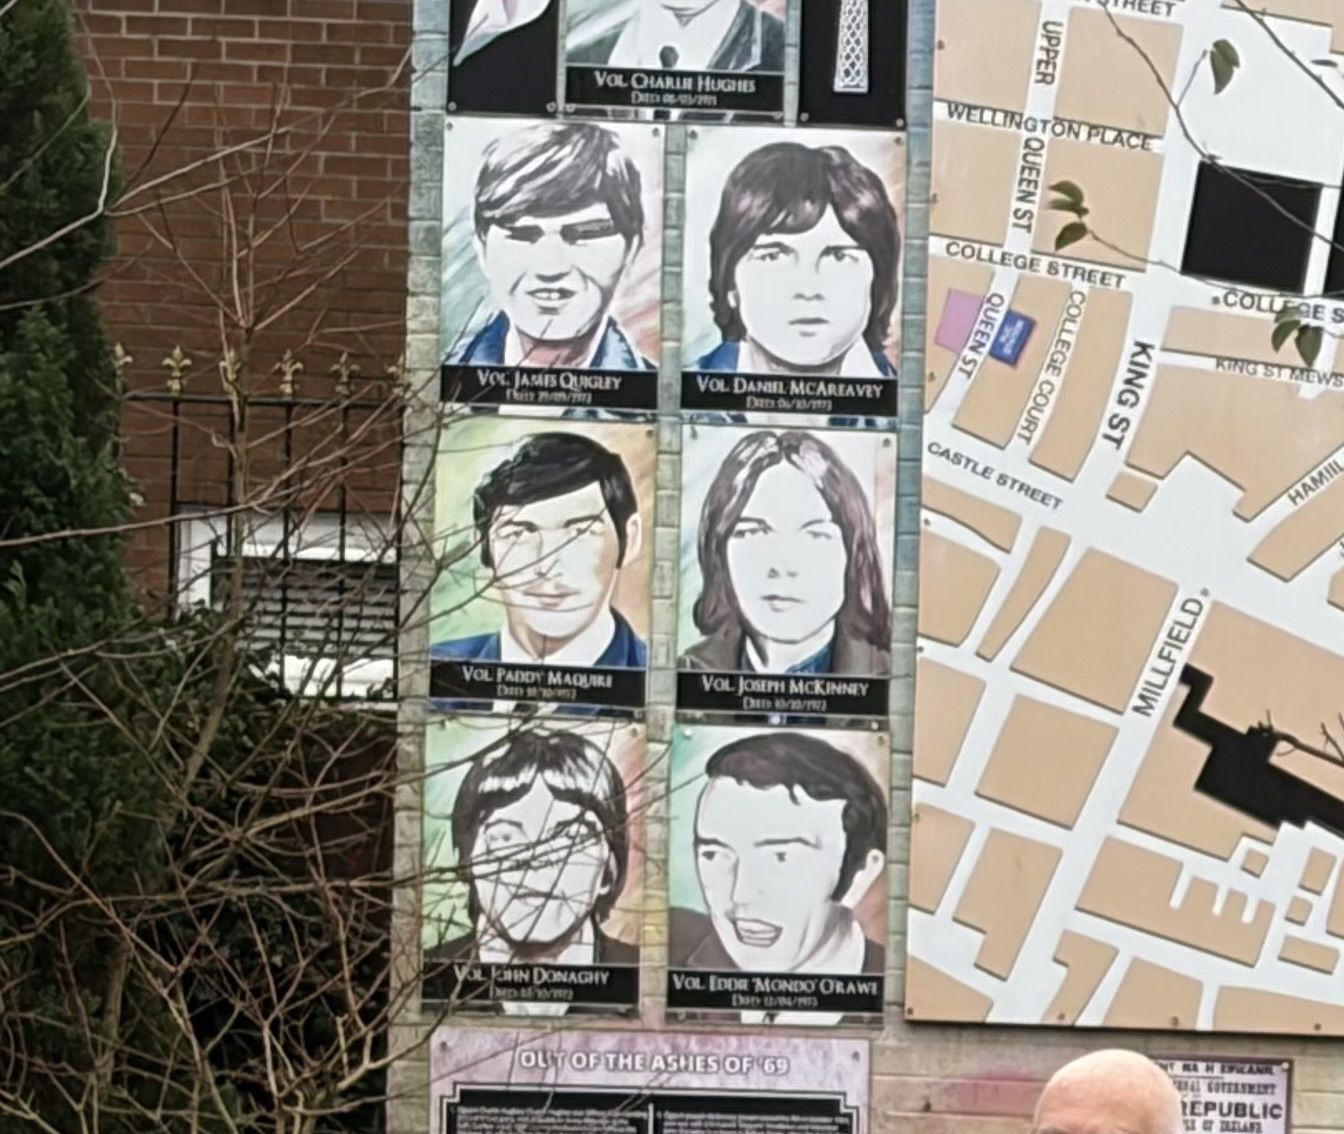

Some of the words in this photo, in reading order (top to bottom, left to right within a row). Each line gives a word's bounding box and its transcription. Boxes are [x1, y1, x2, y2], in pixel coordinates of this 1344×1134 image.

[1033, 19, 1063, 87] UPPER
[631, 72, 693, 91] CHARLIE
[697, 75, 756, 93] HUGHES
[946, 102, 1082, 143] WELLINGTON
[1085, 125, 1153, 152] PLACE
[1015, 136, 1046, 202] QUEEN
[1012, 206, 1036, 234] ST
[945, 240, 1041, 274] COLLEGE
[1046, 260, 1127, 290] STREET
[1044, 289, 1086, 377] COLLEGE
[558, 371, 622, 391] QUIGLEY
[733, 377, 786, 395] DANIEL
[1118, 340, 1155, 409] KING
[1019, 378, 1056, 445] COURT
[1102, 416, 1131, 450] ST
[926, 441, 995, 481] CASTLE
[999, 472, 1064, 511] STREET
[496, 667, 542, 684] PADDY
[1131, 597, 1204, 718] MILLFIELD
[737, 676, 785, 696] JOSEPH
[533, 967, 610, 985] DONAGHY
[518, 1050, 565, 1070] OUT
[571, 1051, 601, 1071] OF
[604, 1053, 647, 1072] THE
[650, 1053, 719, 1074] ASHES
[725, 1055, 754, 1075] OF
